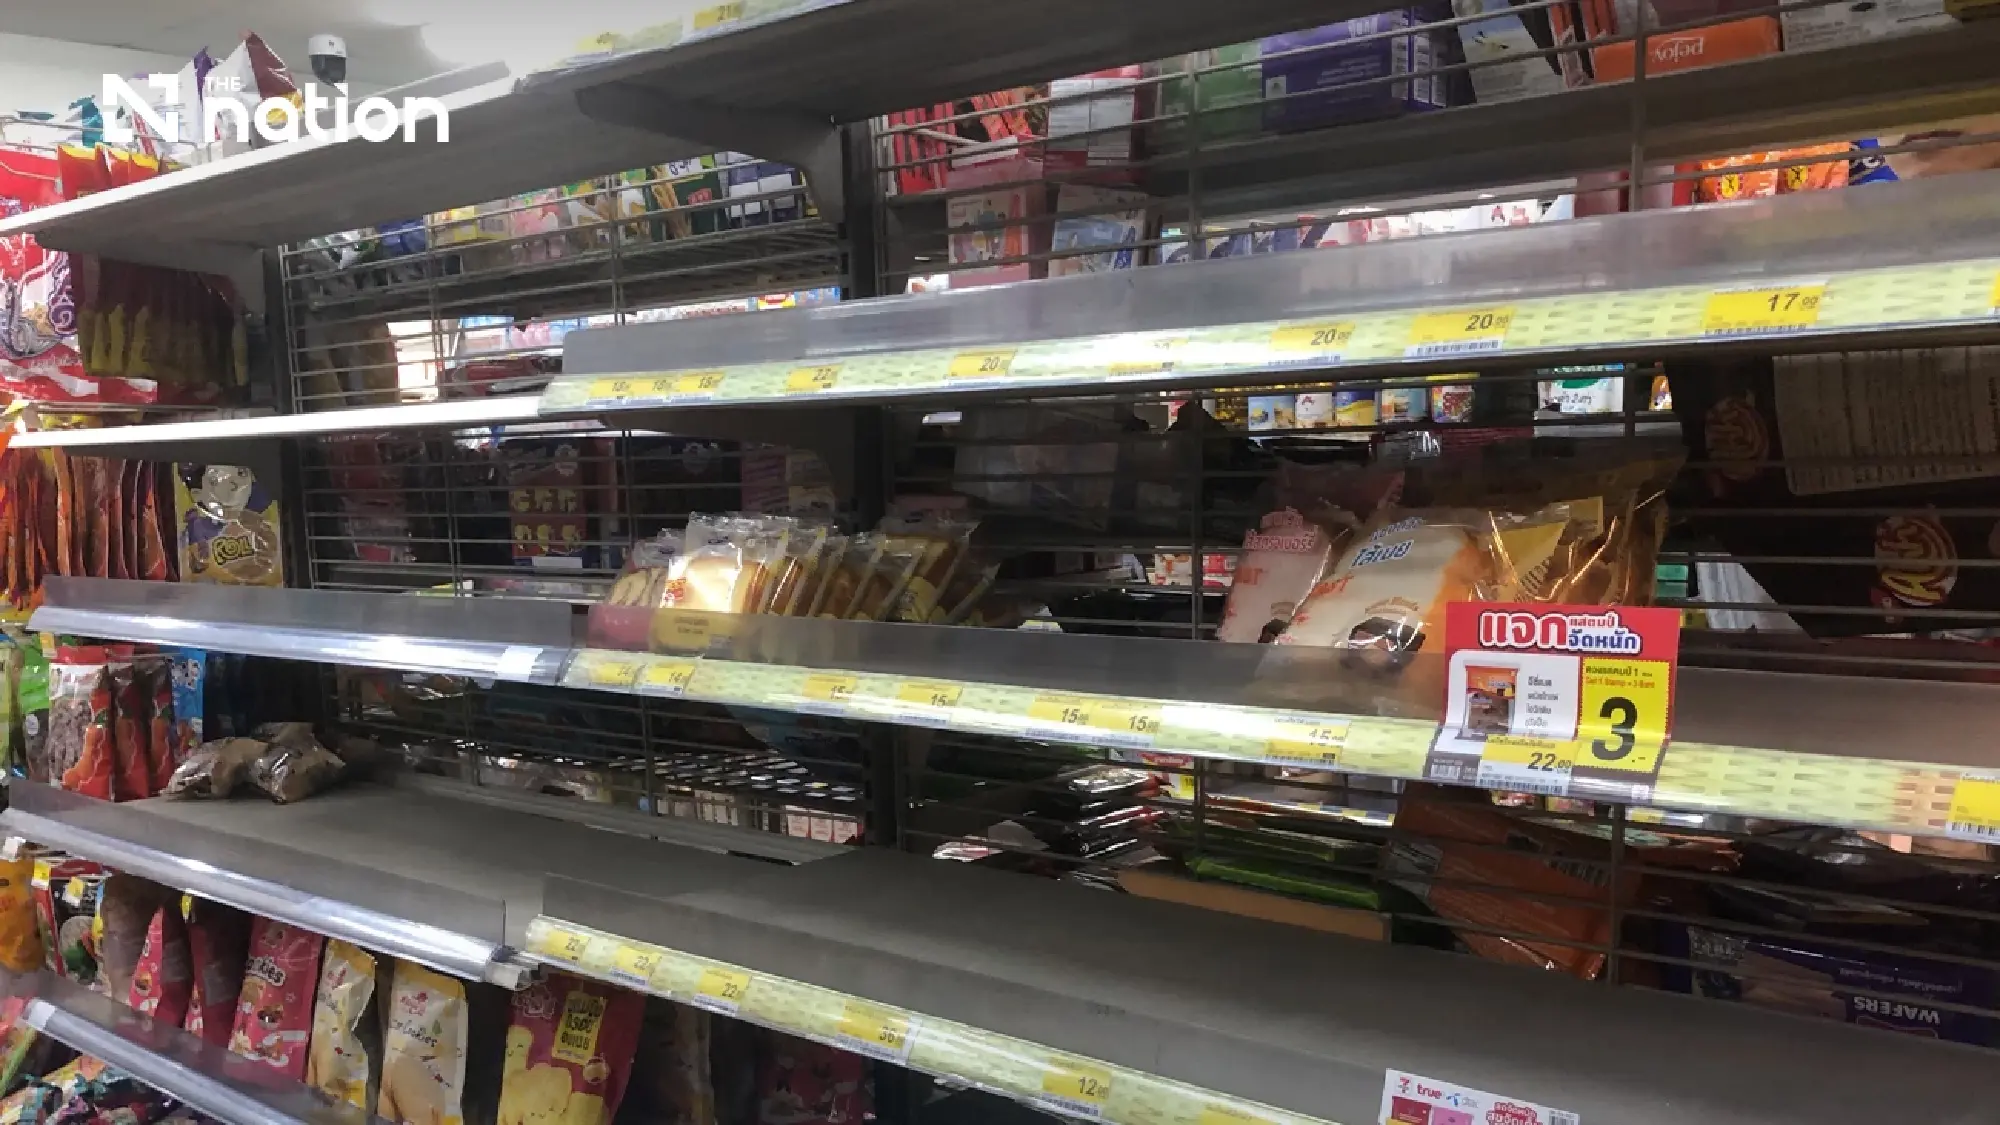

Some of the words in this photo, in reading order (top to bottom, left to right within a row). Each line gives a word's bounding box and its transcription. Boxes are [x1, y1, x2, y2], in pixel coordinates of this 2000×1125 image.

[1767, 292, 1801, 312] 17
[1465, 313, 1493, 331] 20
[1310, 328, 1337, 345] 20
[979, 356, 999, 372] 20
[1482, 614, 1567, 646] แจก
[1568, 629, 1637, 650] จัดหนัก
[1061, 707, 1079, 724] 15
[1128, 715, 1147, 732] 15
[1854, 996, 1941, 1025] WAFERS
[1078, 1076, 1098, 1096] 12
[1416, 1083, 1442, 1100] true
